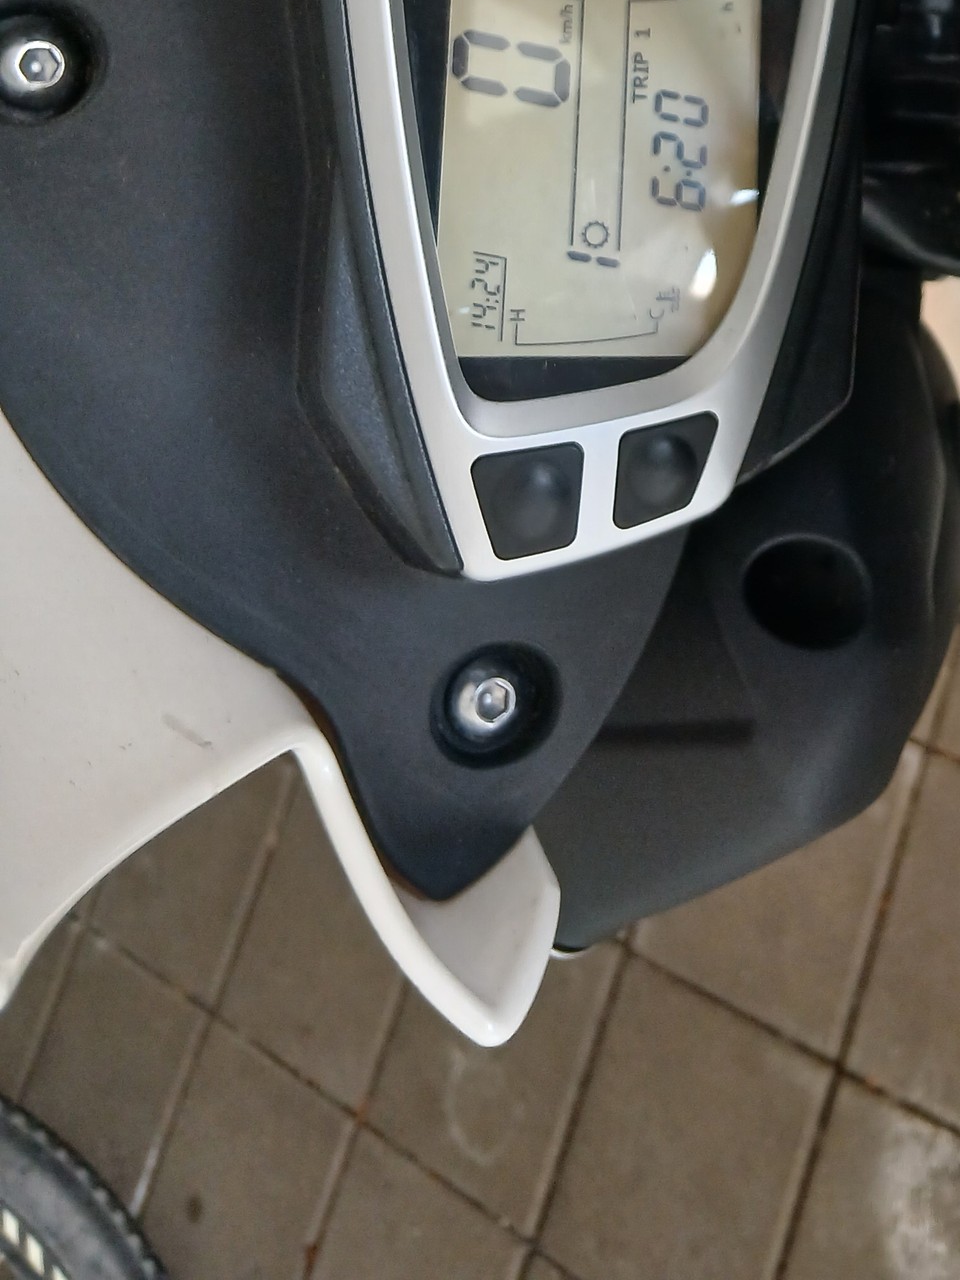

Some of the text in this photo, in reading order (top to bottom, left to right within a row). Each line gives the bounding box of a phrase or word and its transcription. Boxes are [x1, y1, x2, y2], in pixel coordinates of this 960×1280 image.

[559, 3, 575, 45] km/h
[451, 28, 571, 108] 0
[631, 27, 652, 104] TRIP 1
[650, 89, 709, 212] 6:20
[470, 257, 501, 331] 14:24
[510, 308, 526, 323] H
